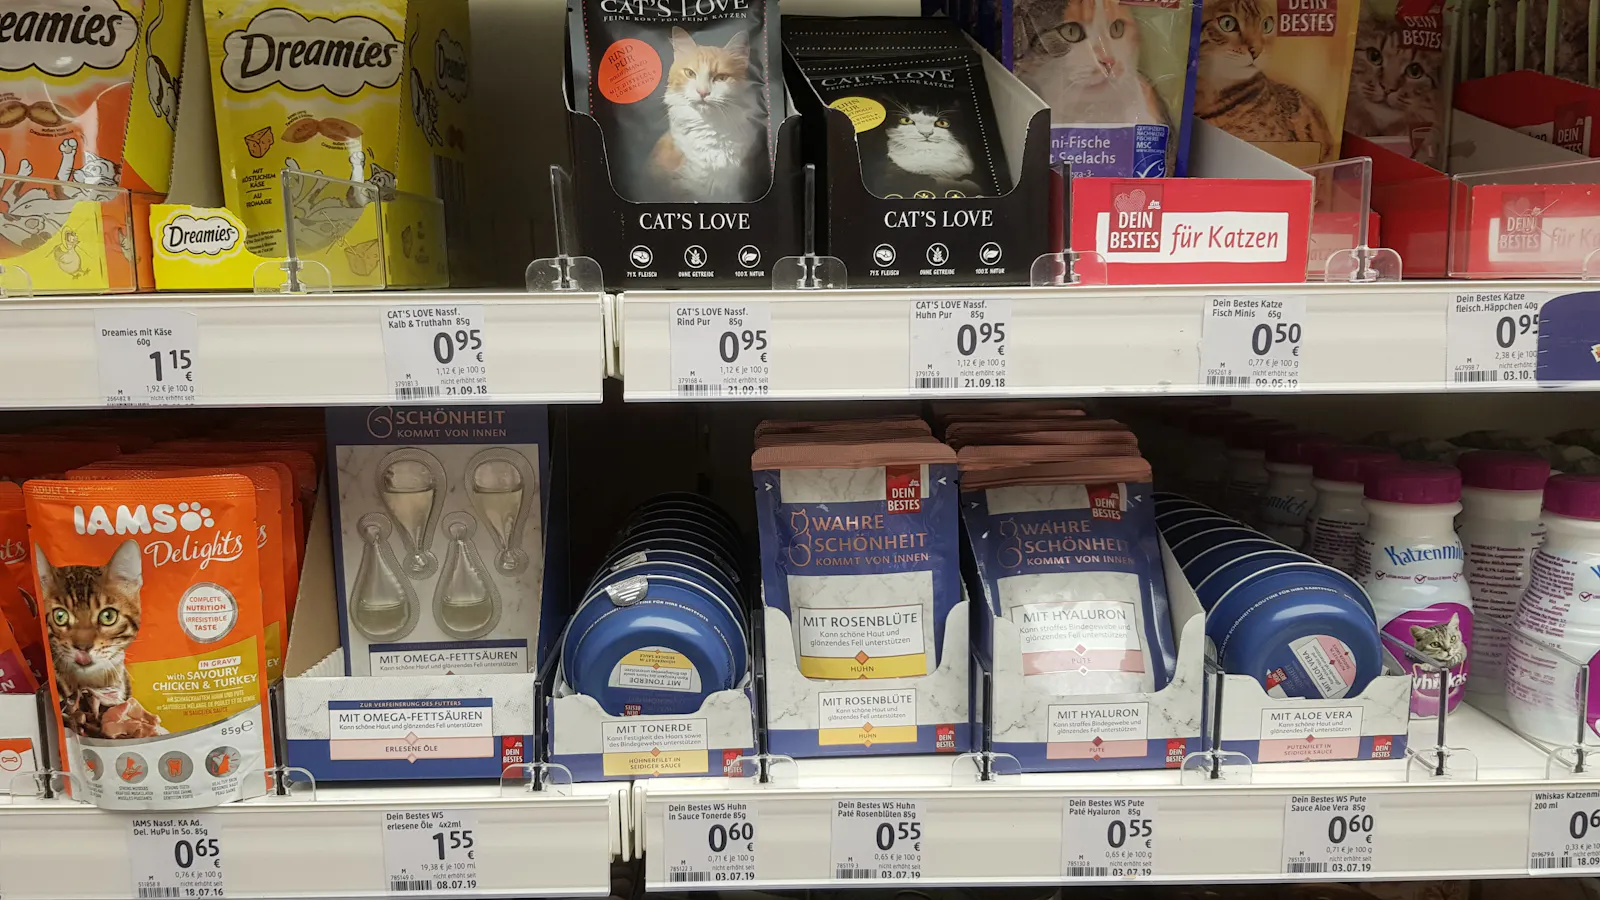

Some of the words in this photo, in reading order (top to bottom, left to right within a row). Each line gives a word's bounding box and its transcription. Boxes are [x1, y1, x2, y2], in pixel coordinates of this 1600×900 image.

[1280, 14, 1334, 32] BESTES
[1405, 15, 1437, 28] DEIN
[1402, 30, 1442, 49] BESTES
[241, 36, 397, 78] Dreamies
[608, 45, 634, 64] RIND
[614, 55, 635, 71] PUR
[1059, 152, 1116, 164] Seelachs
[250, 180, 265, 188] KÄSE
[639, 213, 693, 230] CAT'S
[699, 213, 750, 230] LOVE
[884, 211, 936, 228] CAT'S
[942, 210, 993, 227] LOVE
[1118, 212, 1153, 229] DEIN
[169, 225, 232, 247] Dreamies
[1110, 232, 1160, 249] BESTES
[1170, 224, 1202, 255] für
[1208, 225, 1278, 249] Katzen
[1456, 295, 1474, 303] Dein
[1476, 294, 1502, 302] Bestes
[1504, 293, 1525, 301] Katze
[1213, 299, 1231, 307] Dein
[1233, 300, 1259, 308] Bestes
[1261, 300, 1283, 308] Katze
[1524, 302, 1538, 311] 40g
[388, 310, 411, 319] CAT'S
[413, 309, 433, 317] LOVE
[436, 308, 460, 316] Nassf.
[677, 308, 700, 316] CAT'S
[702, 308, 722, 316] LOVE
[724, 308, 748, 316] Nassf.
[916, 311, 936, 319] Huhn
[939, 311, 952, 319] Pur
[970, 311, 984, 319] 85g
[1213, 309, 1233, 317] Fisch
[1235, 310, 1256, 318] Minis
[1268, 311, 1281, 319] 65g
[389, 320, 406, 328] Kalb
[416, 319, 452, 327] Truthahn
[456, 318, 470, 326] 85g
[677, 318, 695, 326] Rind
[697, 318, 710, 326] Pur
[729, 318, 743, 327] 85g
[140, 328, 152, 336] mit
[154, 328, 172, 336] Käse
[137, 338, 151, 346] 60g
[964, 378, 1005, 388] 21.09.18
[446, 385, 487, 395] 21.09.18
[395, 408, 505, 425] SCHÖNHEIT
[398, 430, 440, 438] KOMMT
[445, 429, 469, 437] VON
[472, 429, 506, 437] INNEN
[892, 488, 915, 499] DEIN
[888, 499, 920, 512] BESTES
[74, 503, 176, 535] IAMS
[812, 514, 884, 531] WAHRE
[814, 533, 927, 552] SCHÖNHEIT
[144, 530, 244, 570] Delights
[816, 557, 861, 566] KOMMT
[866, 556, 890, 565] VON
[894, 553, 929, 563] INNEN
[185, 615, 227, 623] IRRESISTIBLE
[803, 616, 828, 627] MIT
[831, 612, 917, 627] ROSENBLÜTE
[211, 658, 237, 666] GRAVY
[167, 672, 185, 681] with
[187, 667, 239, 680] SAVOURY
[152, 680, 200, 691] CHICKEN
[202, 680, 211, 689] &
[214, 674, 258, 687] TURKEY
[822, 697, 843, 706] MIT
[845, 694, 912, 705] ROSENBLÜTE
[339, 714, 360, 722] MIT
[363, 710, 483, 722] OMEGA-FETTSÄUREN
[1057, 709, 1078, 719] MIT
[1080, 709, 1139, 719] HYALURON
[1271, 712, 1291, 720] MIT
[1294, 712, 1323, 720] ALOE
[1325, 711, 1353, 719] VERA
[616, 725, 636, 733] MIT
[640, 723, 692, 732] TONERDE
[669, 804, 686, 812] Dein
[1069, 808, 1086, 816] Paté
[1087, 809, 1120, 817] Hyaluron
[1128, 808, 1141, 816] 85g
[1352, 804, 1365, 812] 85g
[386, 813, 404, 821] Dein
[733, 812, 746, 820] 85g
[838, 810, 854, 818] Paté
[856, 810, 901, 818] Rosenblüten
[903, 811, 916, 819] 85g
[387, 823, 418, 831] erlesene
[420, 821, 433, 829] Öle
[439, 821, 461, 829] 4x2ml
[195, 828, 208, 836] 85g
[715, 872, 755, 881] 03.07.19
[437, 880, 476, 890] 08.07.19
[185, 889, 223, 897] 18.07.16
